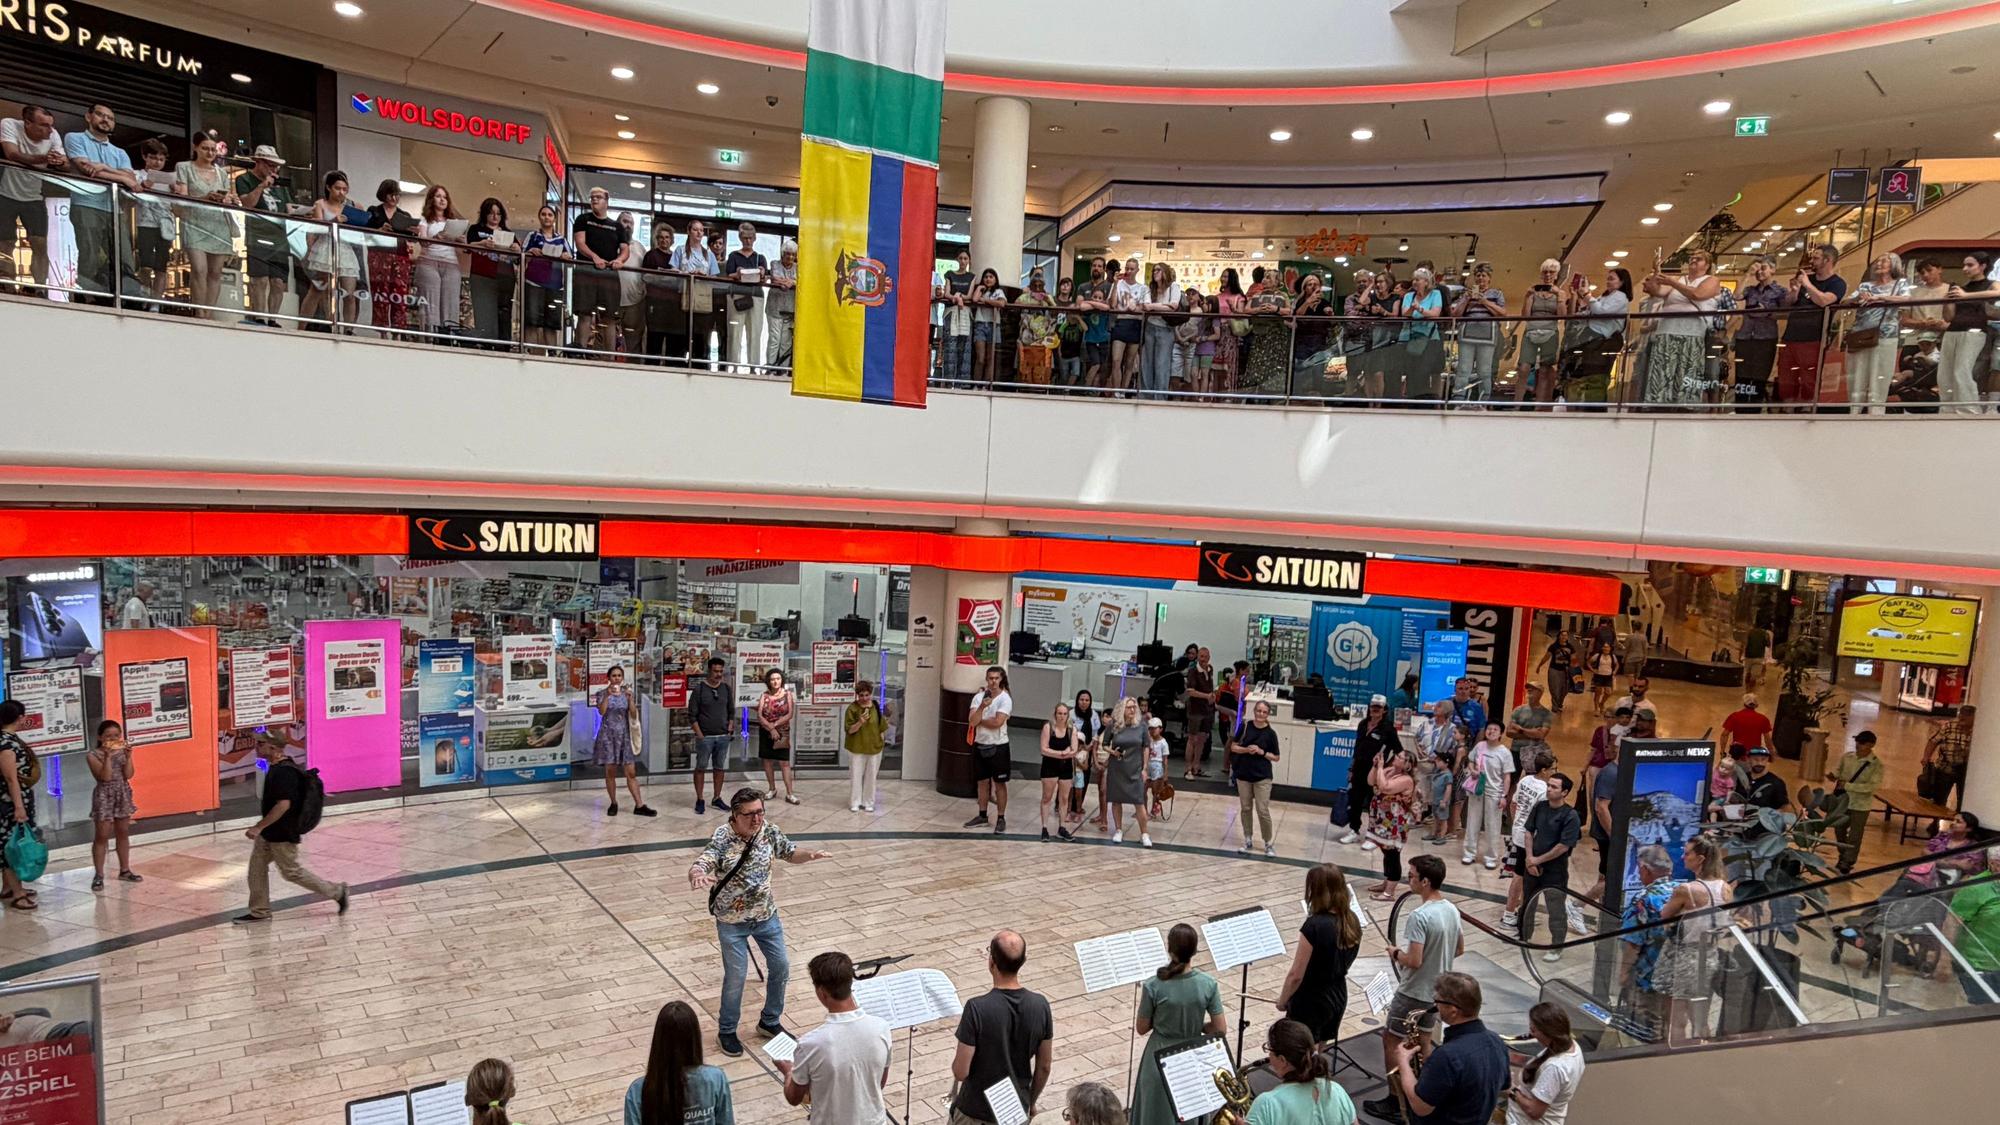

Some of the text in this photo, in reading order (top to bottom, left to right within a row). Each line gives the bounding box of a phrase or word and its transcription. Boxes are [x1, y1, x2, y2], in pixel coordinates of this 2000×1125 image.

[78, 27, 202, 75] PARFUM
[376, 95, 532, 144] WOLSDORFF
[479, 520, 595, 553] SATURN
[1255, 555, 1361, 590] SATURN
[1340, 638, 1365, 653] G+
[11, 673, 55, 684] Samsung
[123, 665, 150, 675] Apple
[155, 711, 189, 723] 63,99€
[47, 723, 82, 735] 58,99€
[1687, 747, 1711, 756] NEWS
[25, 1042, 73, 1063] BEIM
[0, 1065, 49, 1084] ALL-
[0, 1074, 76, 1100] ZSPIEL
